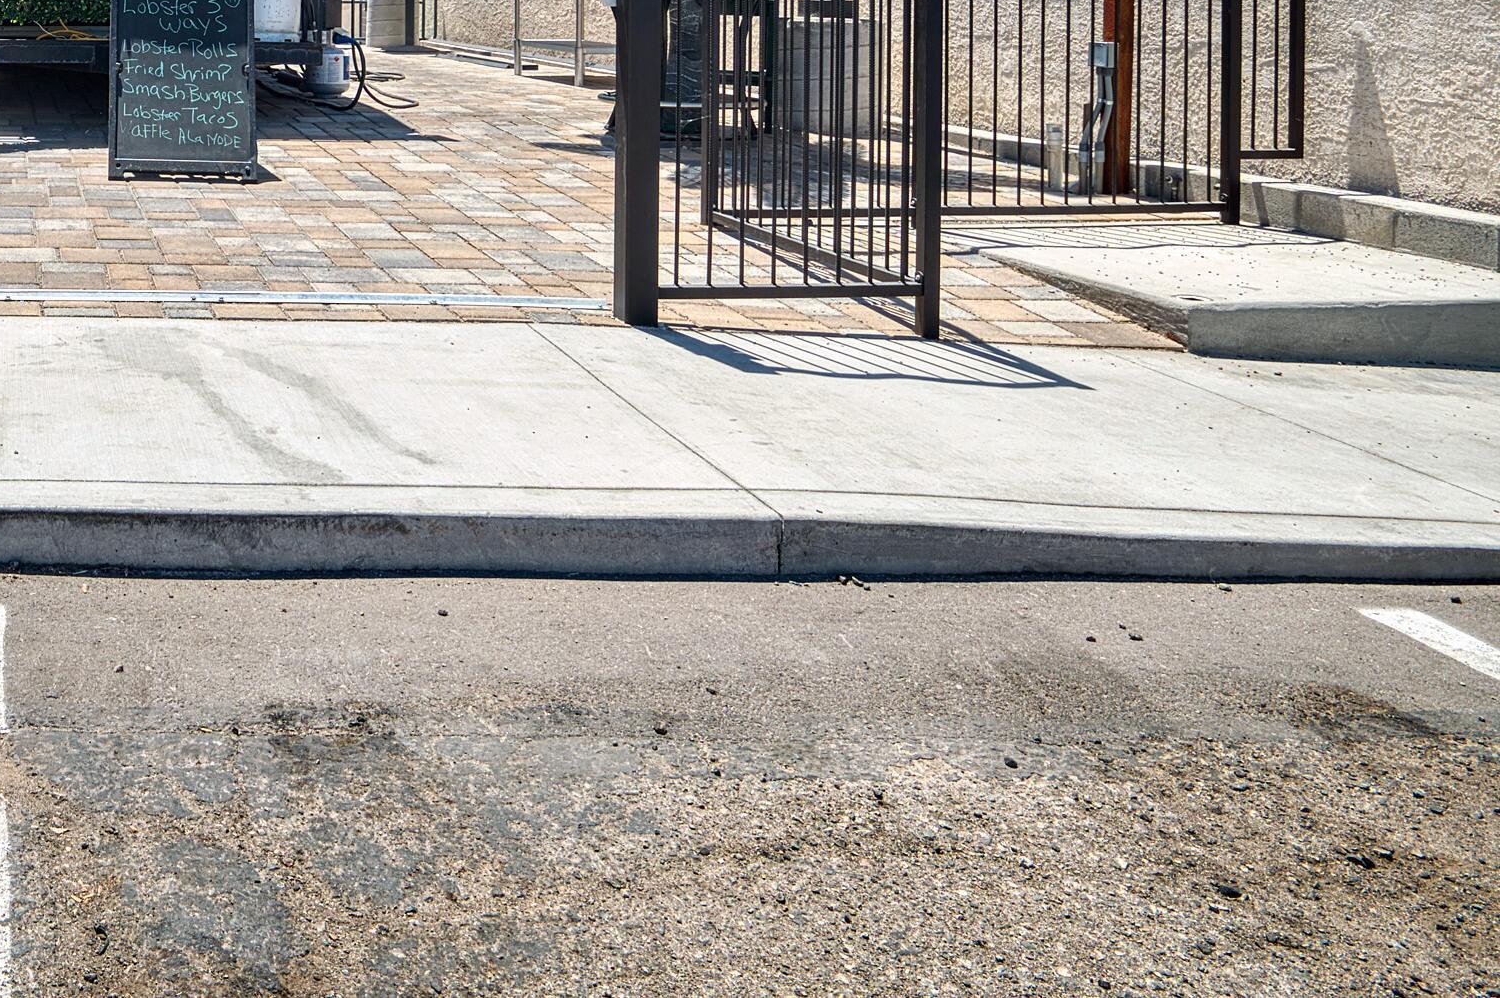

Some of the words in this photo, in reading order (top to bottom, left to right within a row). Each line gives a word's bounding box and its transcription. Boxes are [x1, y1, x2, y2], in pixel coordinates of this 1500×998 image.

[122, 38, 189, 55] Lobster
[187, 38, 238, 59] Rolls
[123, 58, 164, 78] Fried
[122, 78, 186, 100] Smash
[184, 83, 244, 110] Burgers
[123, 102, 181, 121] Lobster
[181, 106, 238, 129] Tacos
[207, 133, 242, 149] MODE
